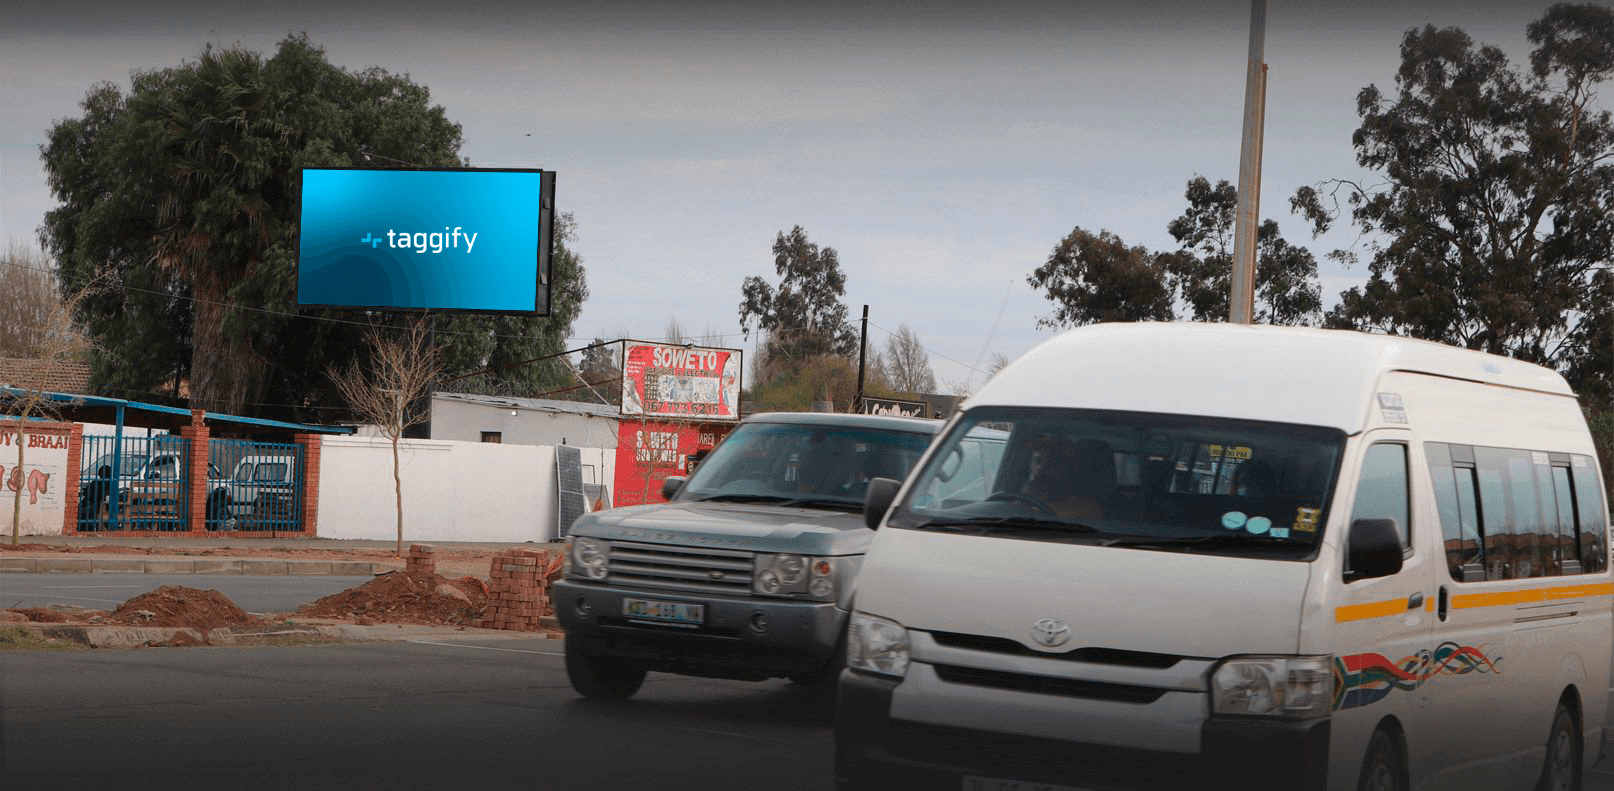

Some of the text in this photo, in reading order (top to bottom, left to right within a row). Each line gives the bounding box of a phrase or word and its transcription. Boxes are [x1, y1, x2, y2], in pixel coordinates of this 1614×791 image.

[387, 226, 478, 253] taggify
[652, 347, 718, 371] SOWETO
[28, 434, 68, 449] BRAAI
[636, 430, 679, 449] SWETO
